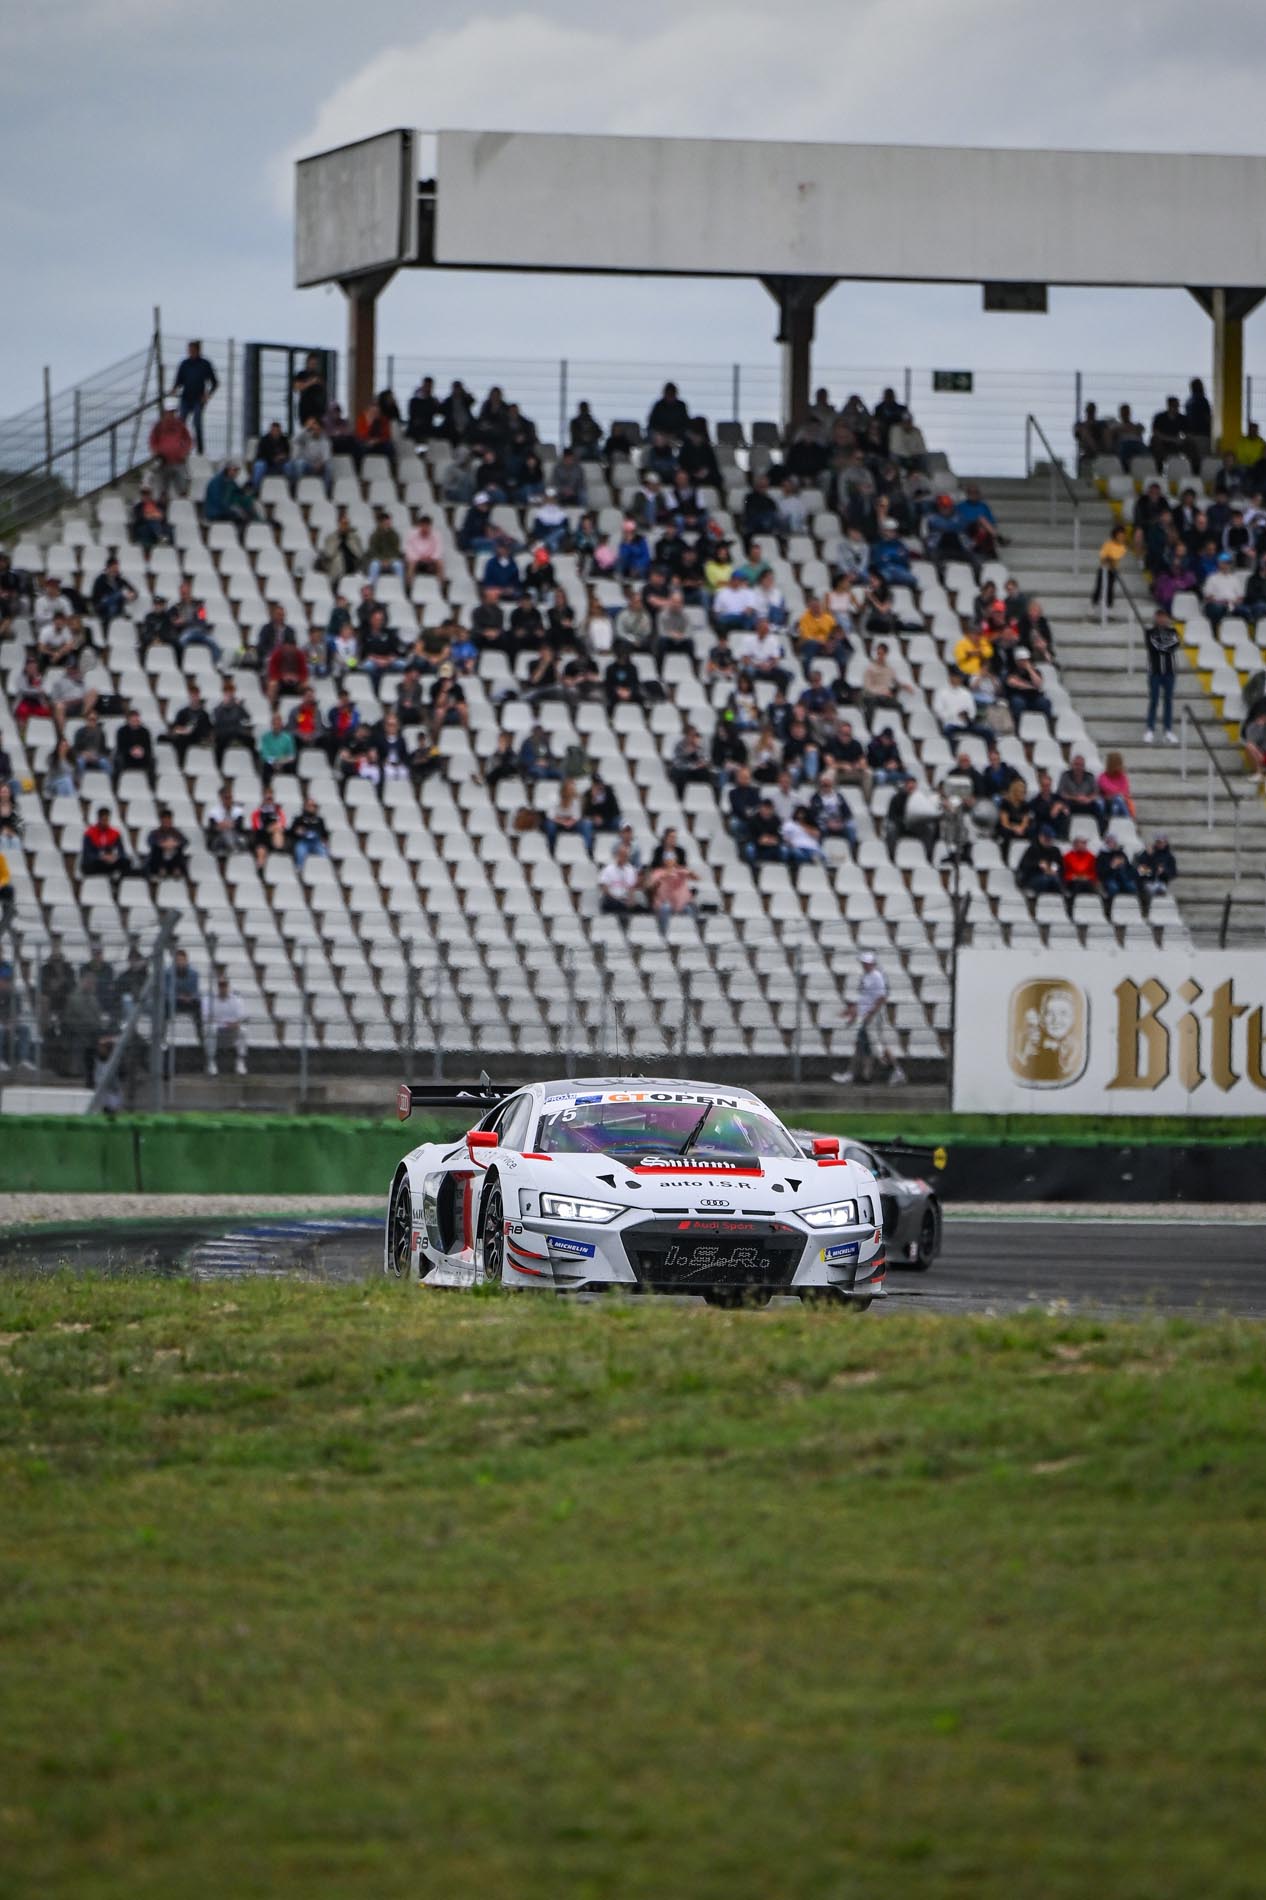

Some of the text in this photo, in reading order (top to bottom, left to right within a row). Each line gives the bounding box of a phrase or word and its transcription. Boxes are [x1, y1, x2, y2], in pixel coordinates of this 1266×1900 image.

[547, 1108, 577, 1126] 75
[660, 1180, 757, 1190] auto I.S.R.
[694, 1220, 756, 1231] Audi Sport
[554, 1241, 589, 1253] MICHELIN
